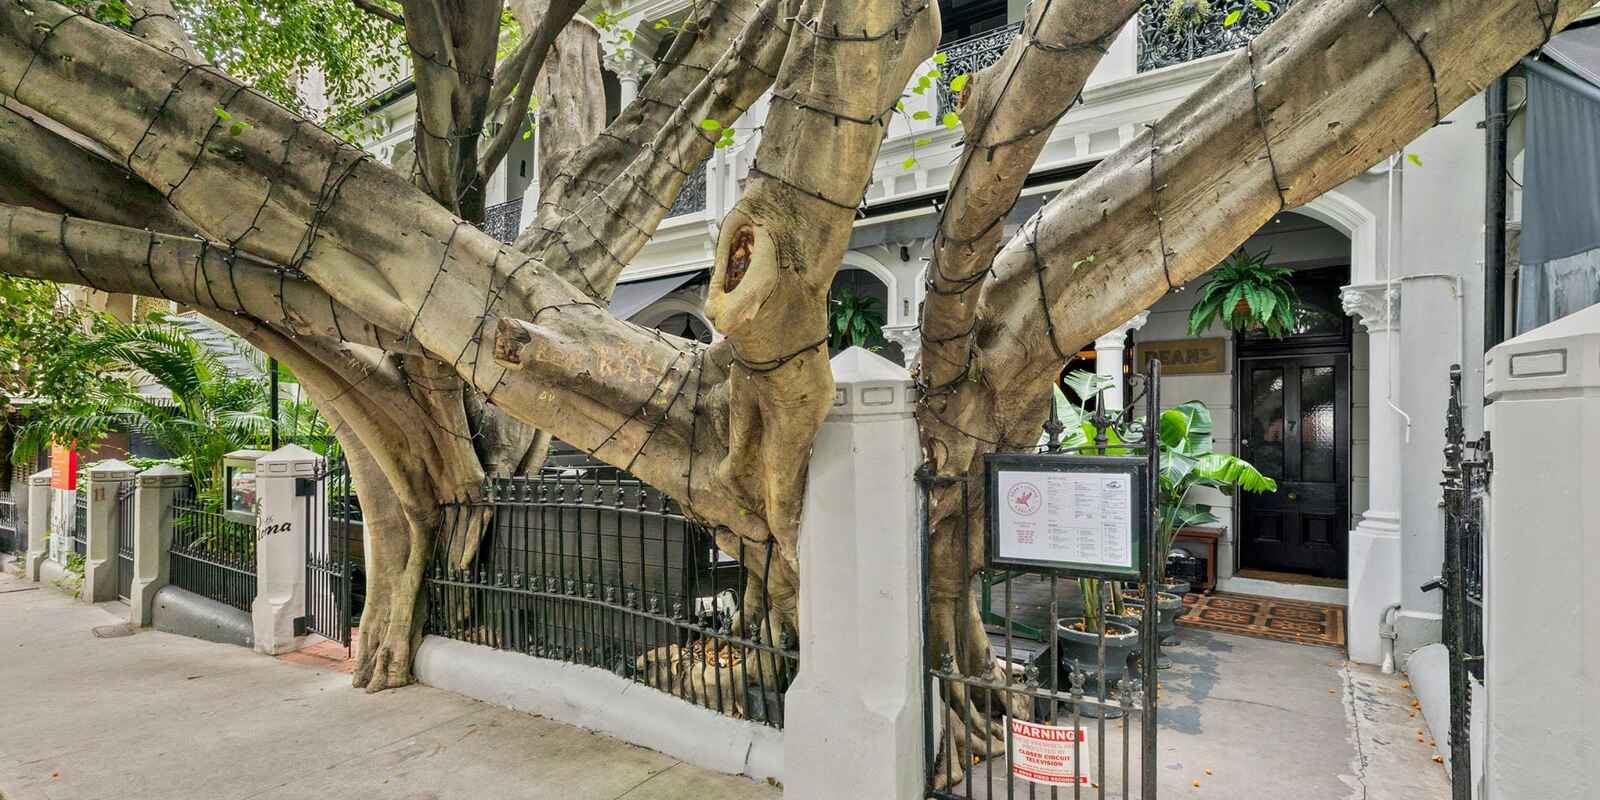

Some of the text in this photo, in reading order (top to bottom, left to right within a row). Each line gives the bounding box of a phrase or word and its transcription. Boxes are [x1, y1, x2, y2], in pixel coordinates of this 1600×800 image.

[1287, 420, 1297, 432] 7
[1012, 722, 1075, 740] WARNING
[1026, 756, 1063, 767] TELEVISION
[1044, 753, 1071, 761] CIRCUIT
